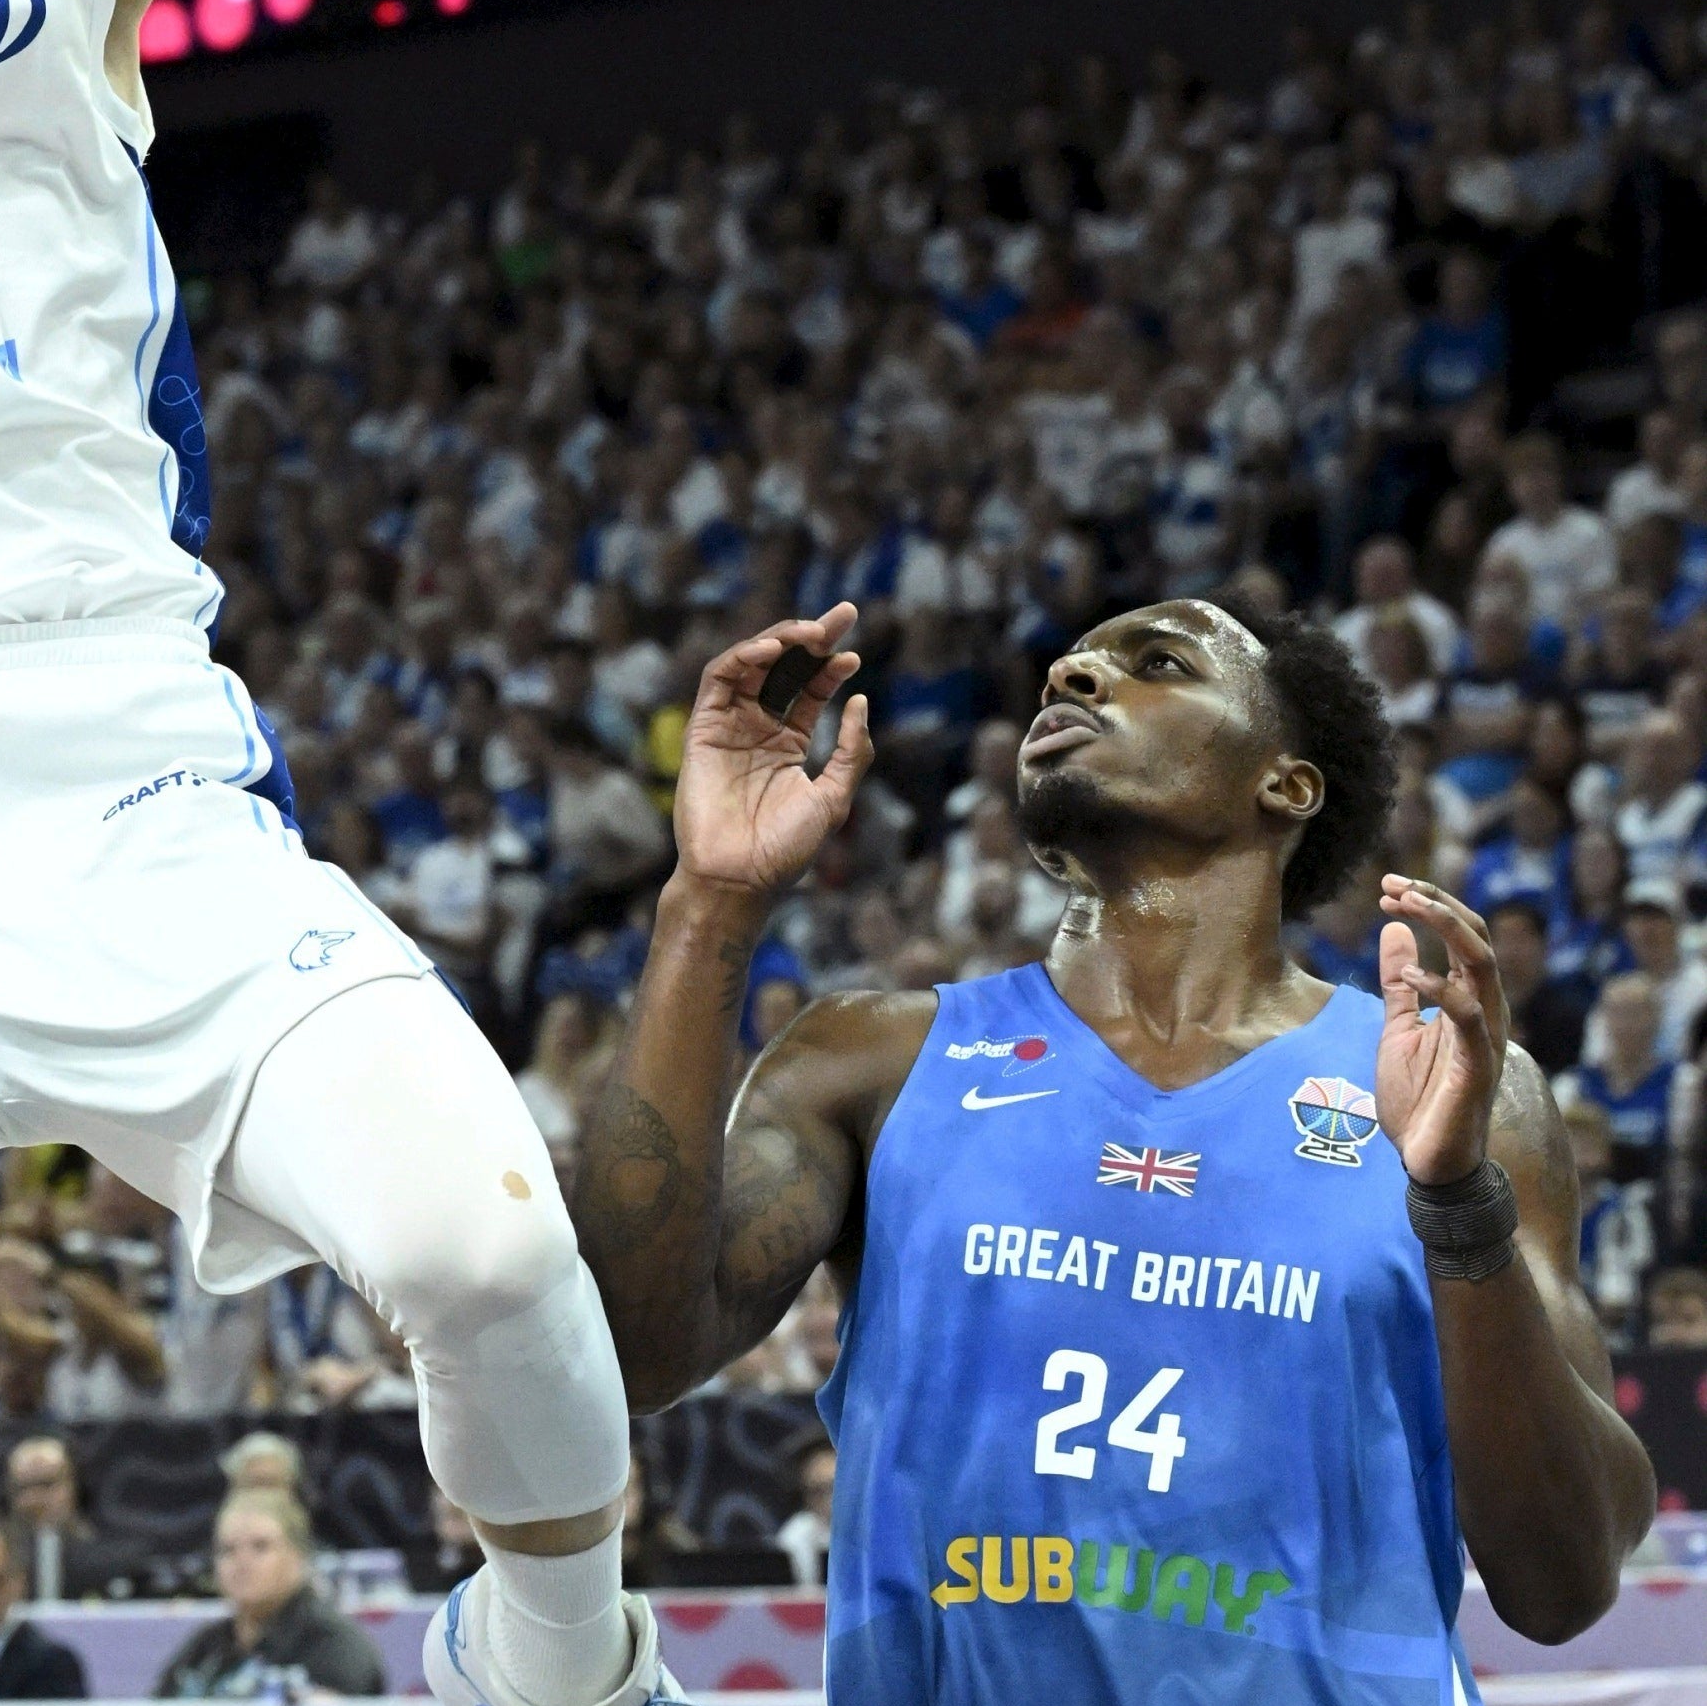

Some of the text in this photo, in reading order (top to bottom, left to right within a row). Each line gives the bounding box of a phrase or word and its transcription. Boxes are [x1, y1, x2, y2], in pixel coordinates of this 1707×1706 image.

[102, 770, 186, 822] CRAFT
[1298, 1137, 1359, 1164] 25
[963, 1222, 1321, 1324] GREAT BRITAIN
[1034, 1349, 1187, 1494] 24
[930, 1535, 1293, 1635] SUBWAY
